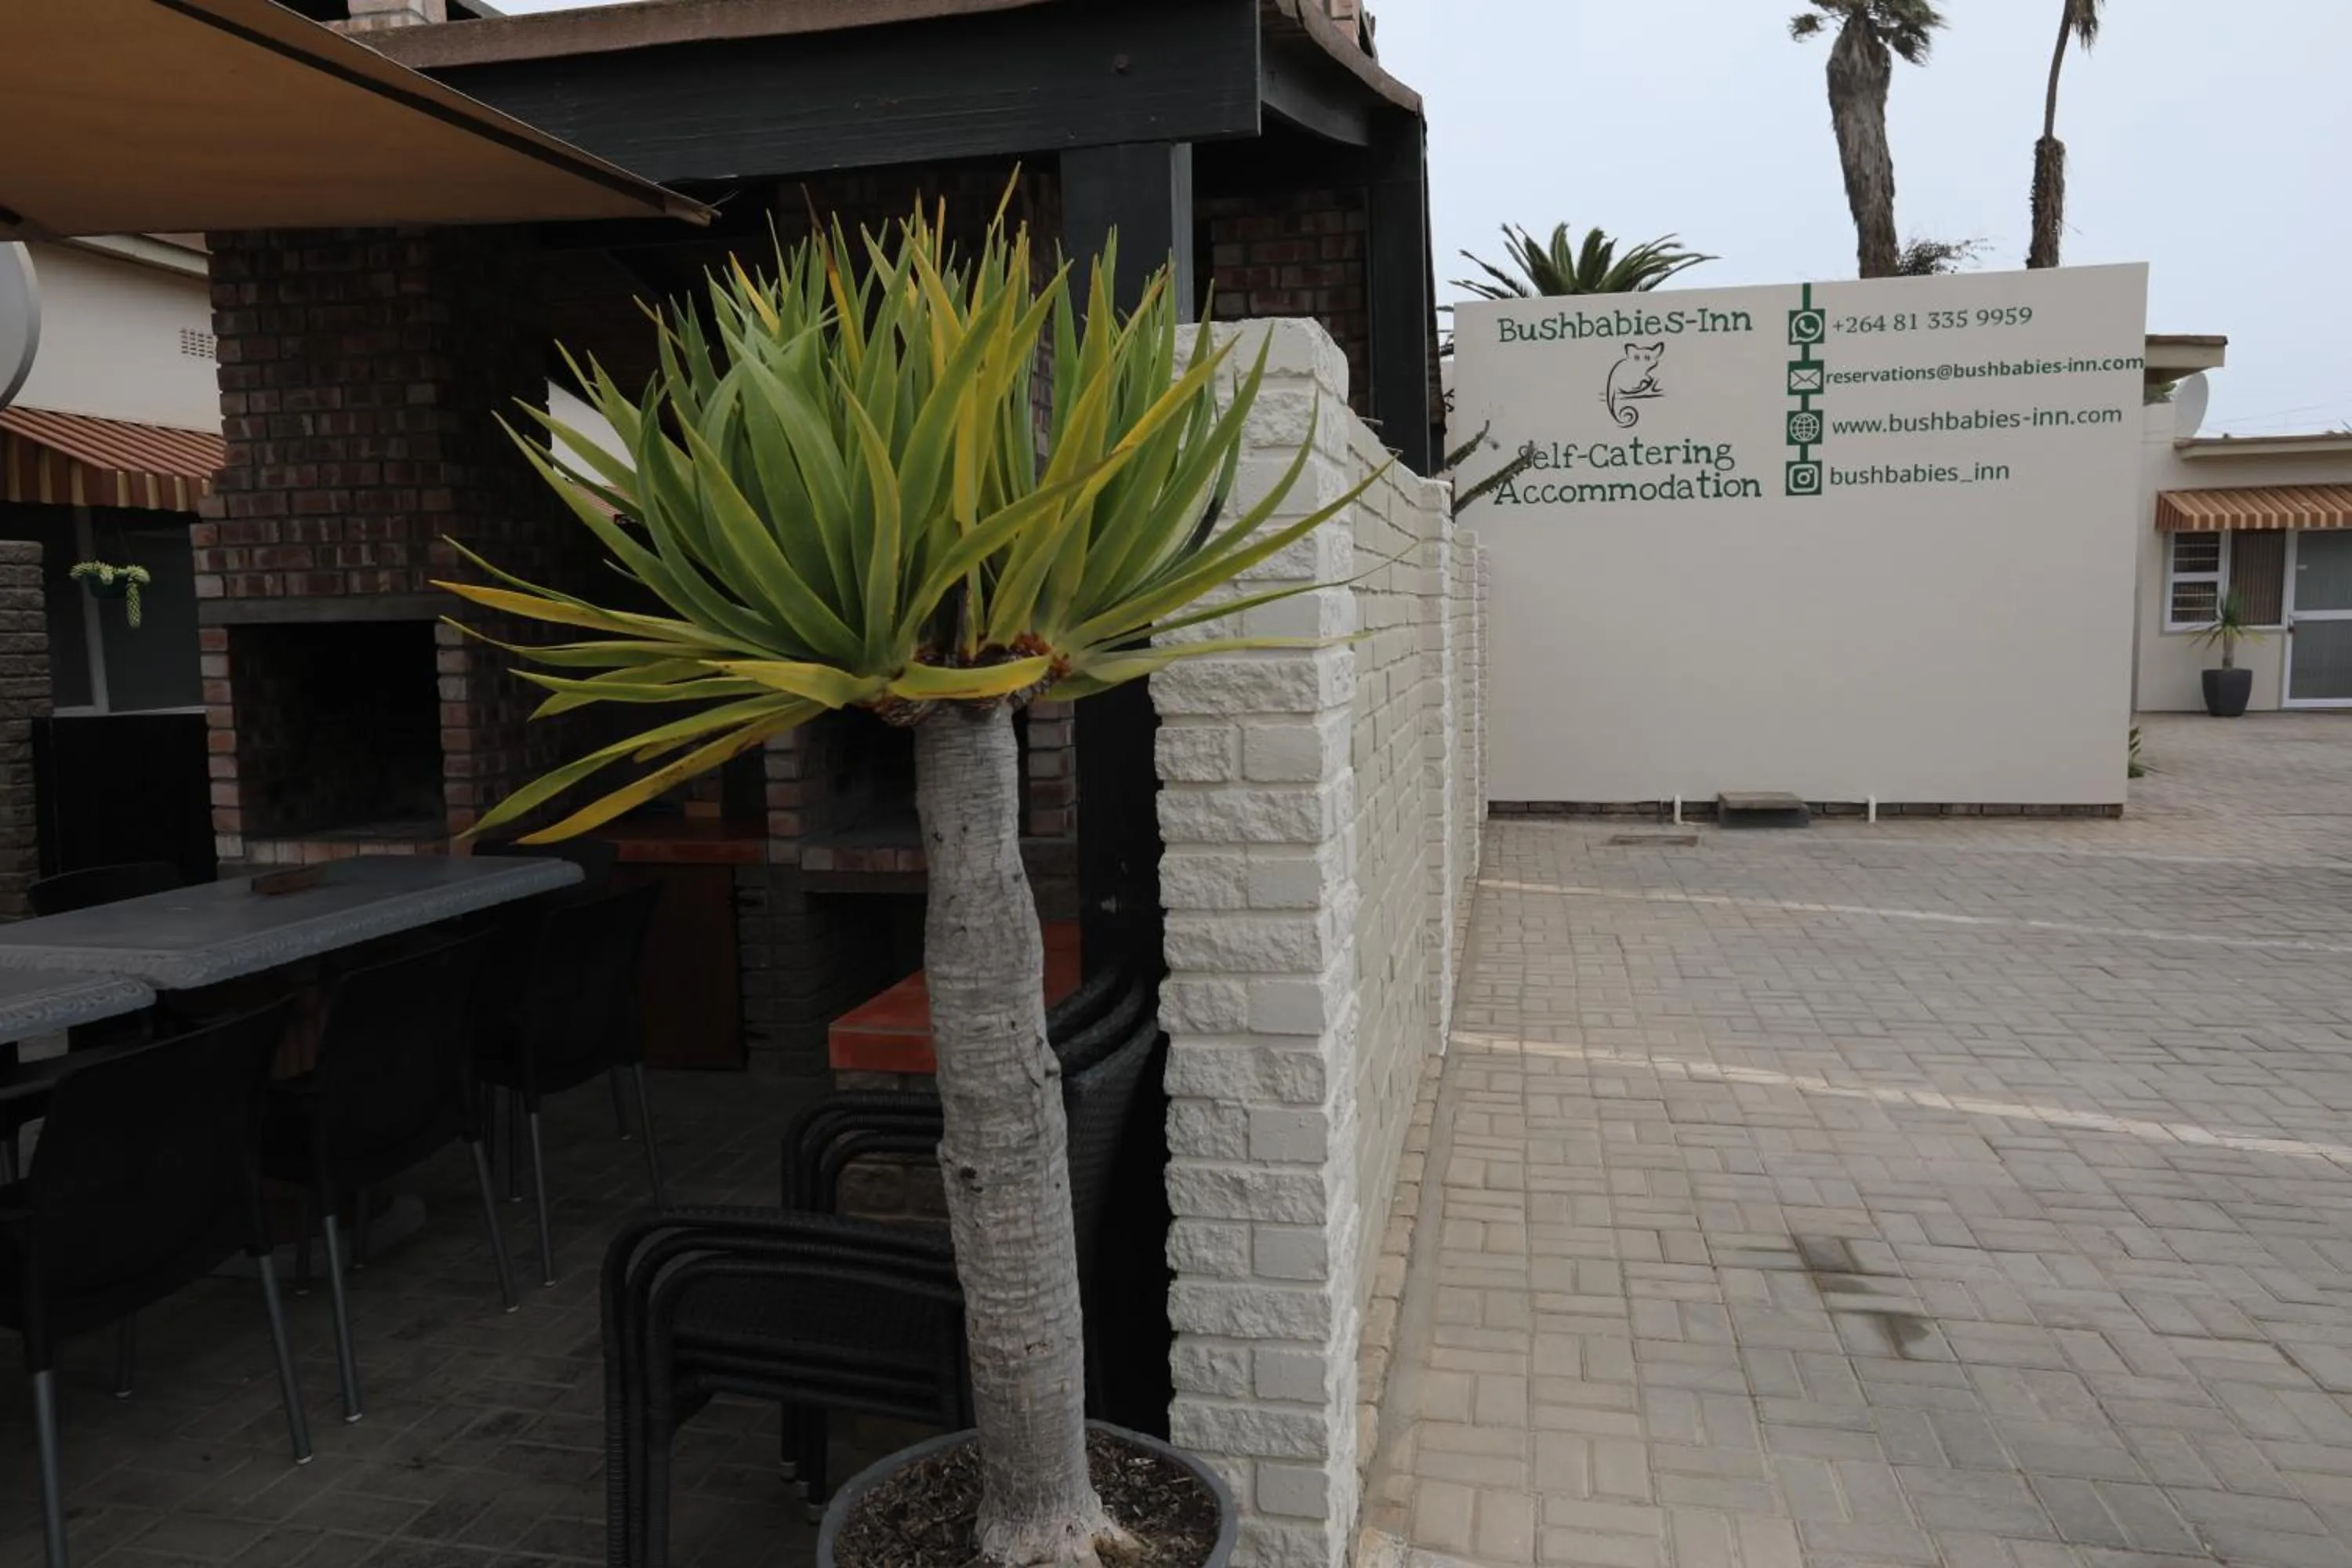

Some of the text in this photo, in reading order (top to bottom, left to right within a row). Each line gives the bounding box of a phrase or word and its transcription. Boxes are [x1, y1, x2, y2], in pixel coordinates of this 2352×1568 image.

[1832, 307, 2033, 334] +264 81 335 9959
[1825, 356, 2144, 384] reservations@bushbabies-inn.com
[1831, 406, 2122, 434] www.bushbabies-inn.com
[1830, 461, 2009, 485] bushbabies_inn
[1494, 470, 1762, 506] Accommodation
